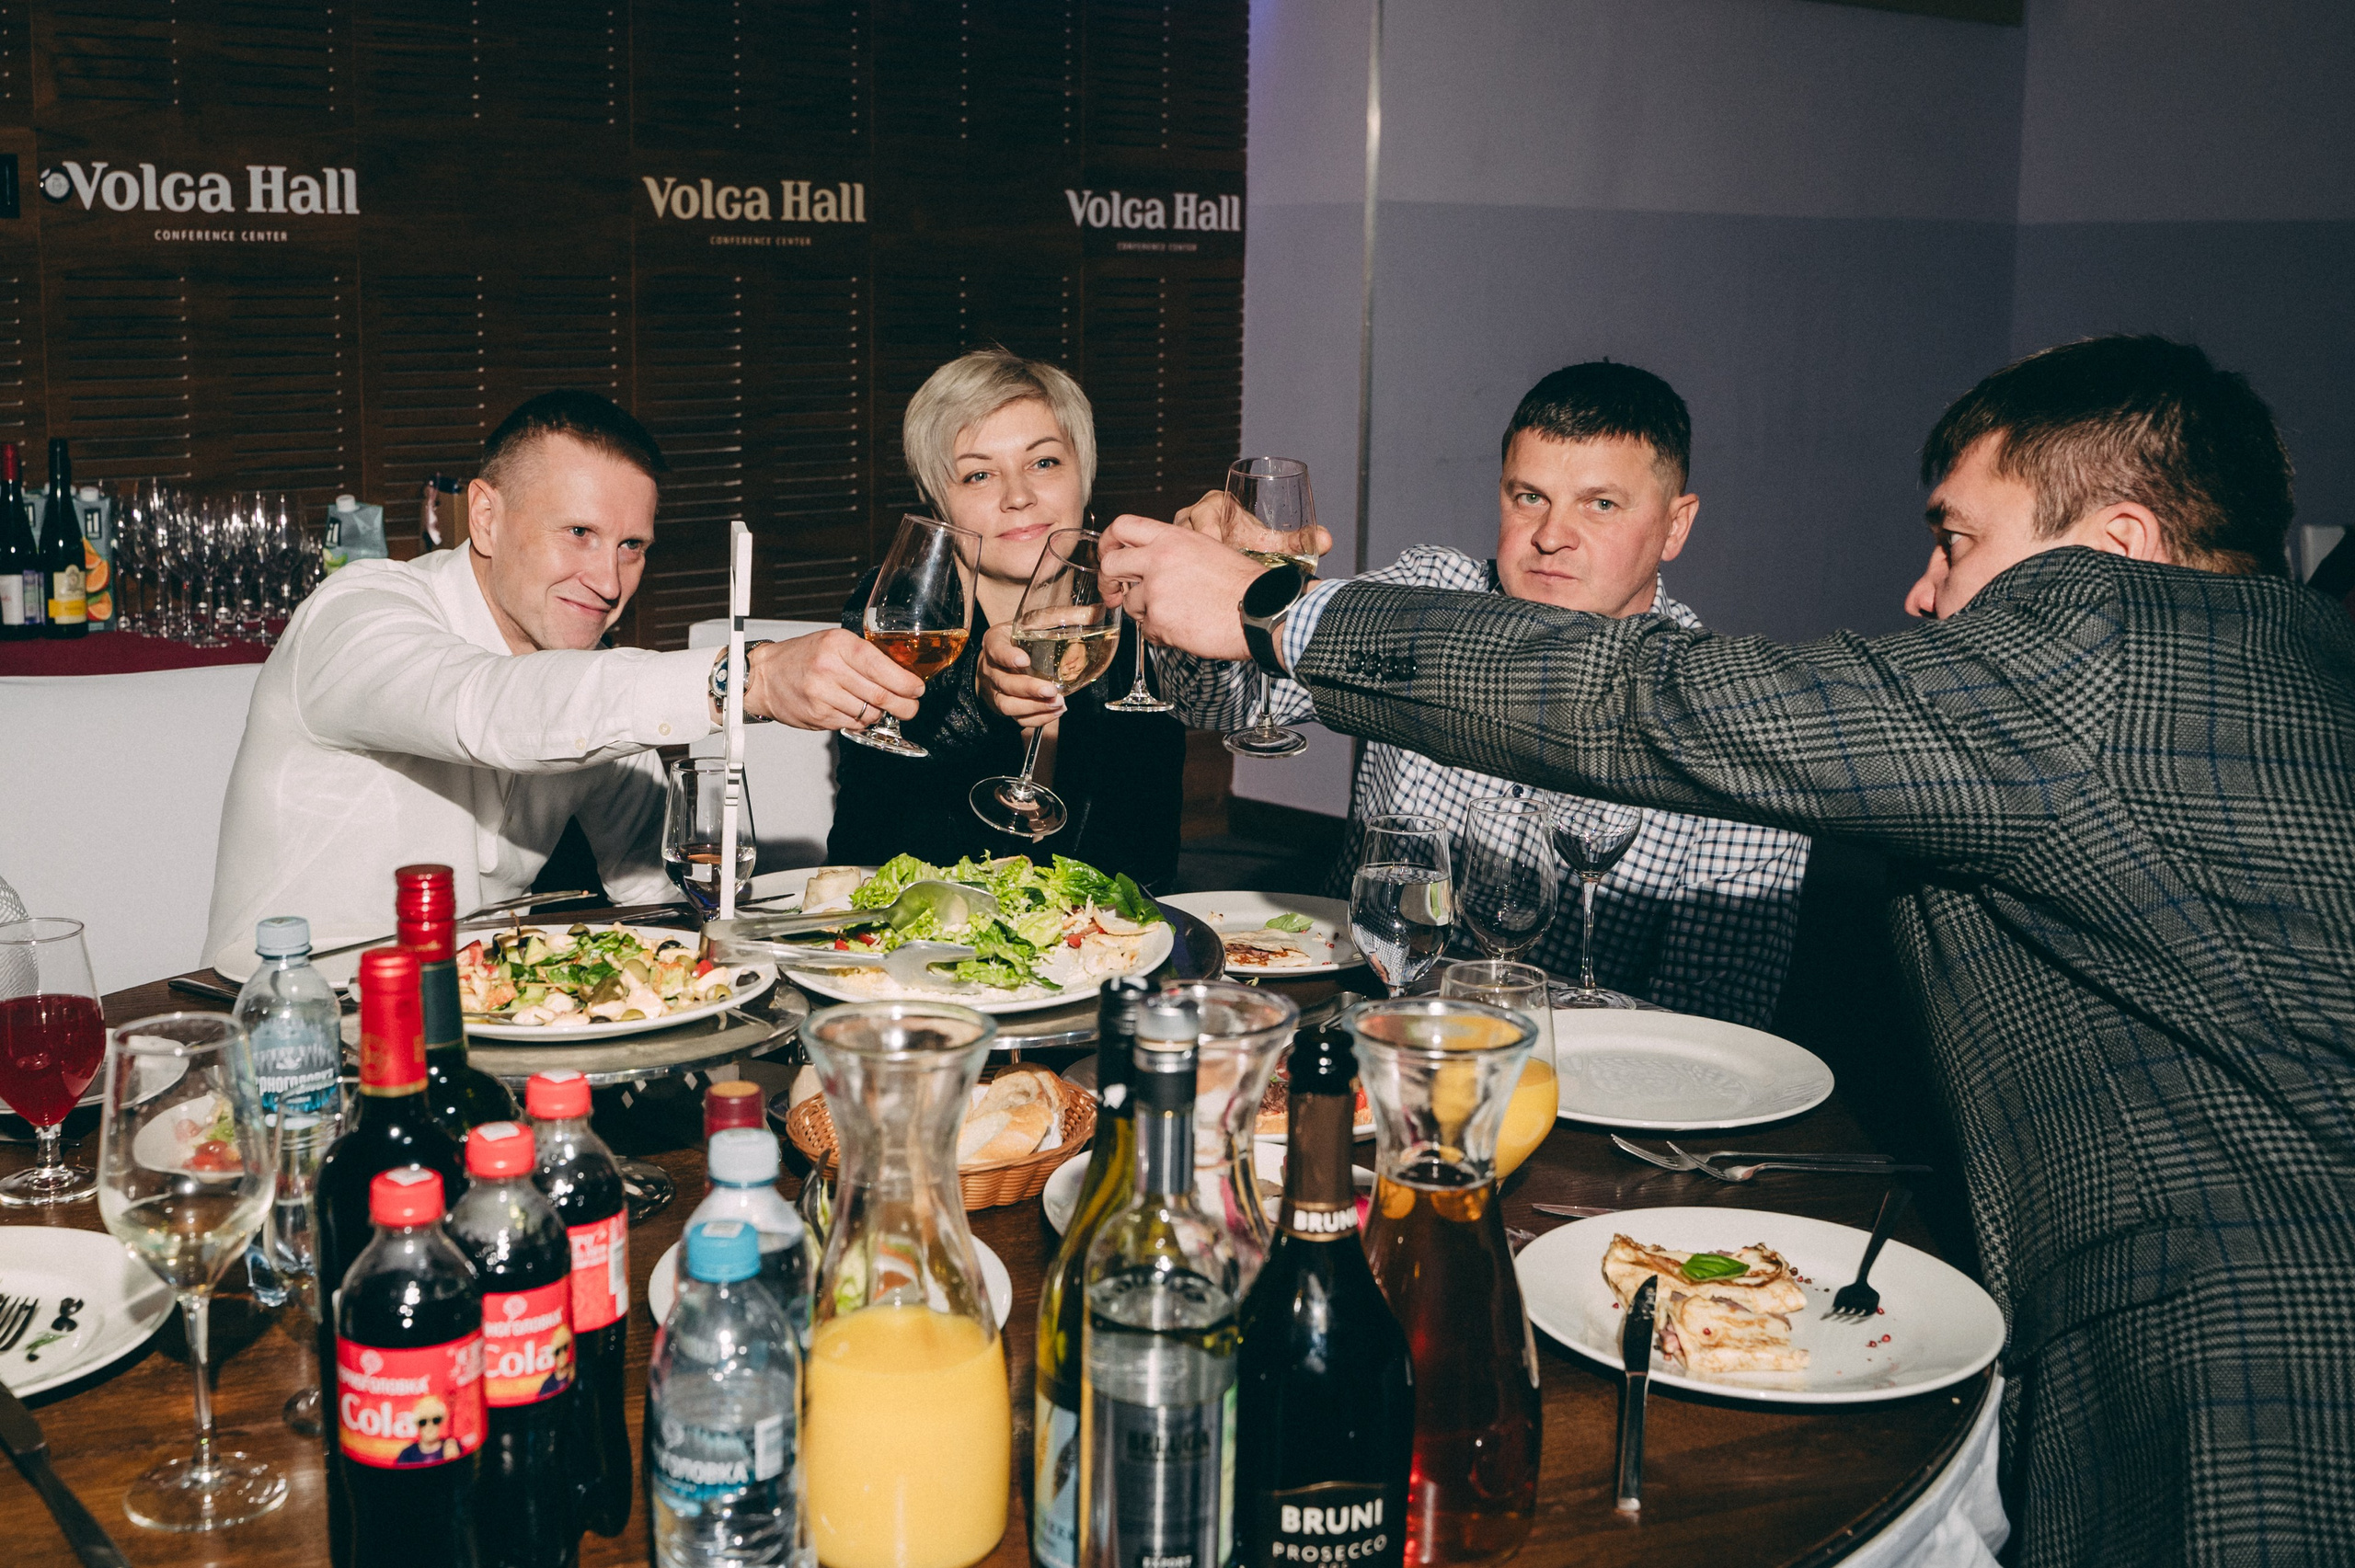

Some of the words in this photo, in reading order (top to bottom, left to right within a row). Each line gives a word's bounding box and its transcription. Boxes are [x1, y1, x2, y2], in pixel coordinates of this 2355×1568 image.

[246, 165, 361, 214] Hall
[780, 179, 867, 223] Hall
[1172, 192, 1241, 232] Hall
[154, 228, 236, 242] CONFERENCE
[241, 230, 288, 243] CENTER
[709, 235, 771, 246] CONFERENCE
[775, 236, 812, 246] CENTER
[484, 1340, 556, 1379] Cola
[340, 1392, 419, 1438] Cola
[1281, 1497, 1384, 1535] BRUNI
[1272, 1534, 1387, 1562] PROSECCO
